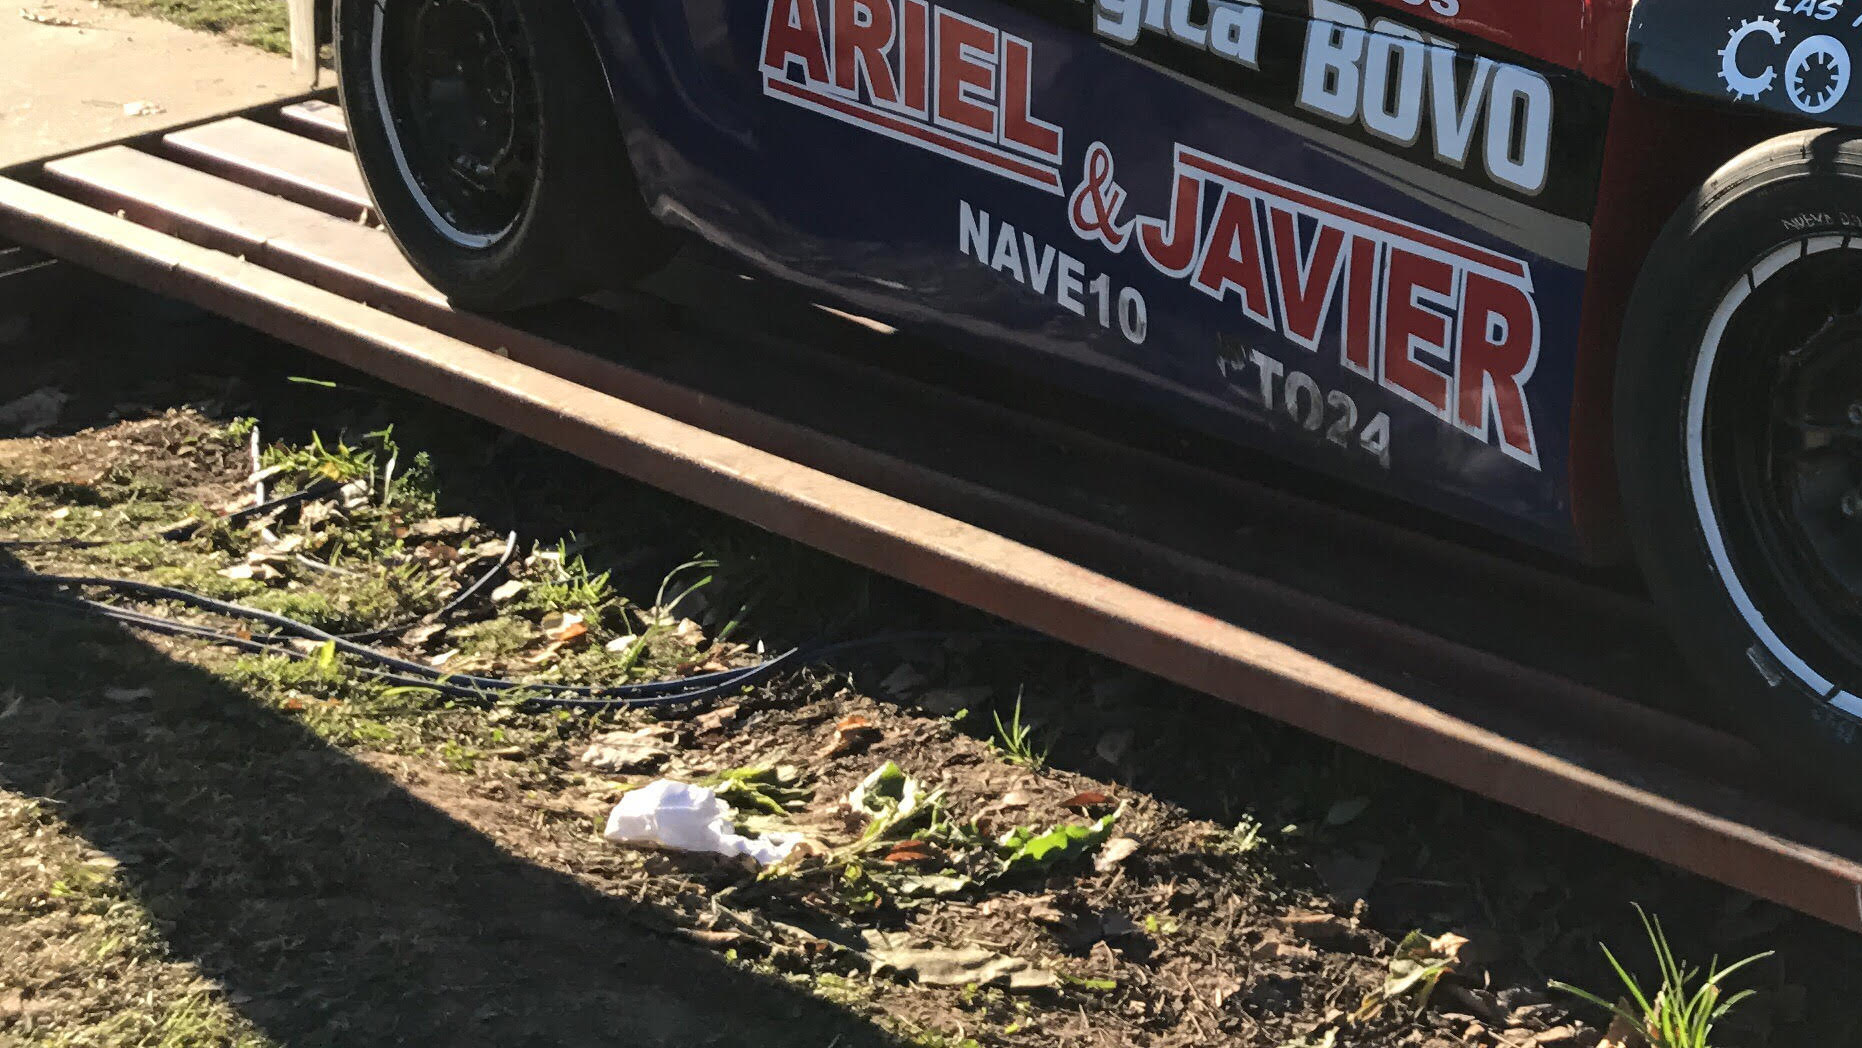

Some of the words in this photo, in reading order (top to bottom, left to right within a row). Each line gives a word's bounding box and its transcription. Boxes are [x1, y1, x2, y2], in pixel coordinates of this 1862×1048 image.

[1067, 141, 1135, 254] &
[959, 199, 1148, 345] NAVE10
[1136, 142, 1543, 472] JAVIER
